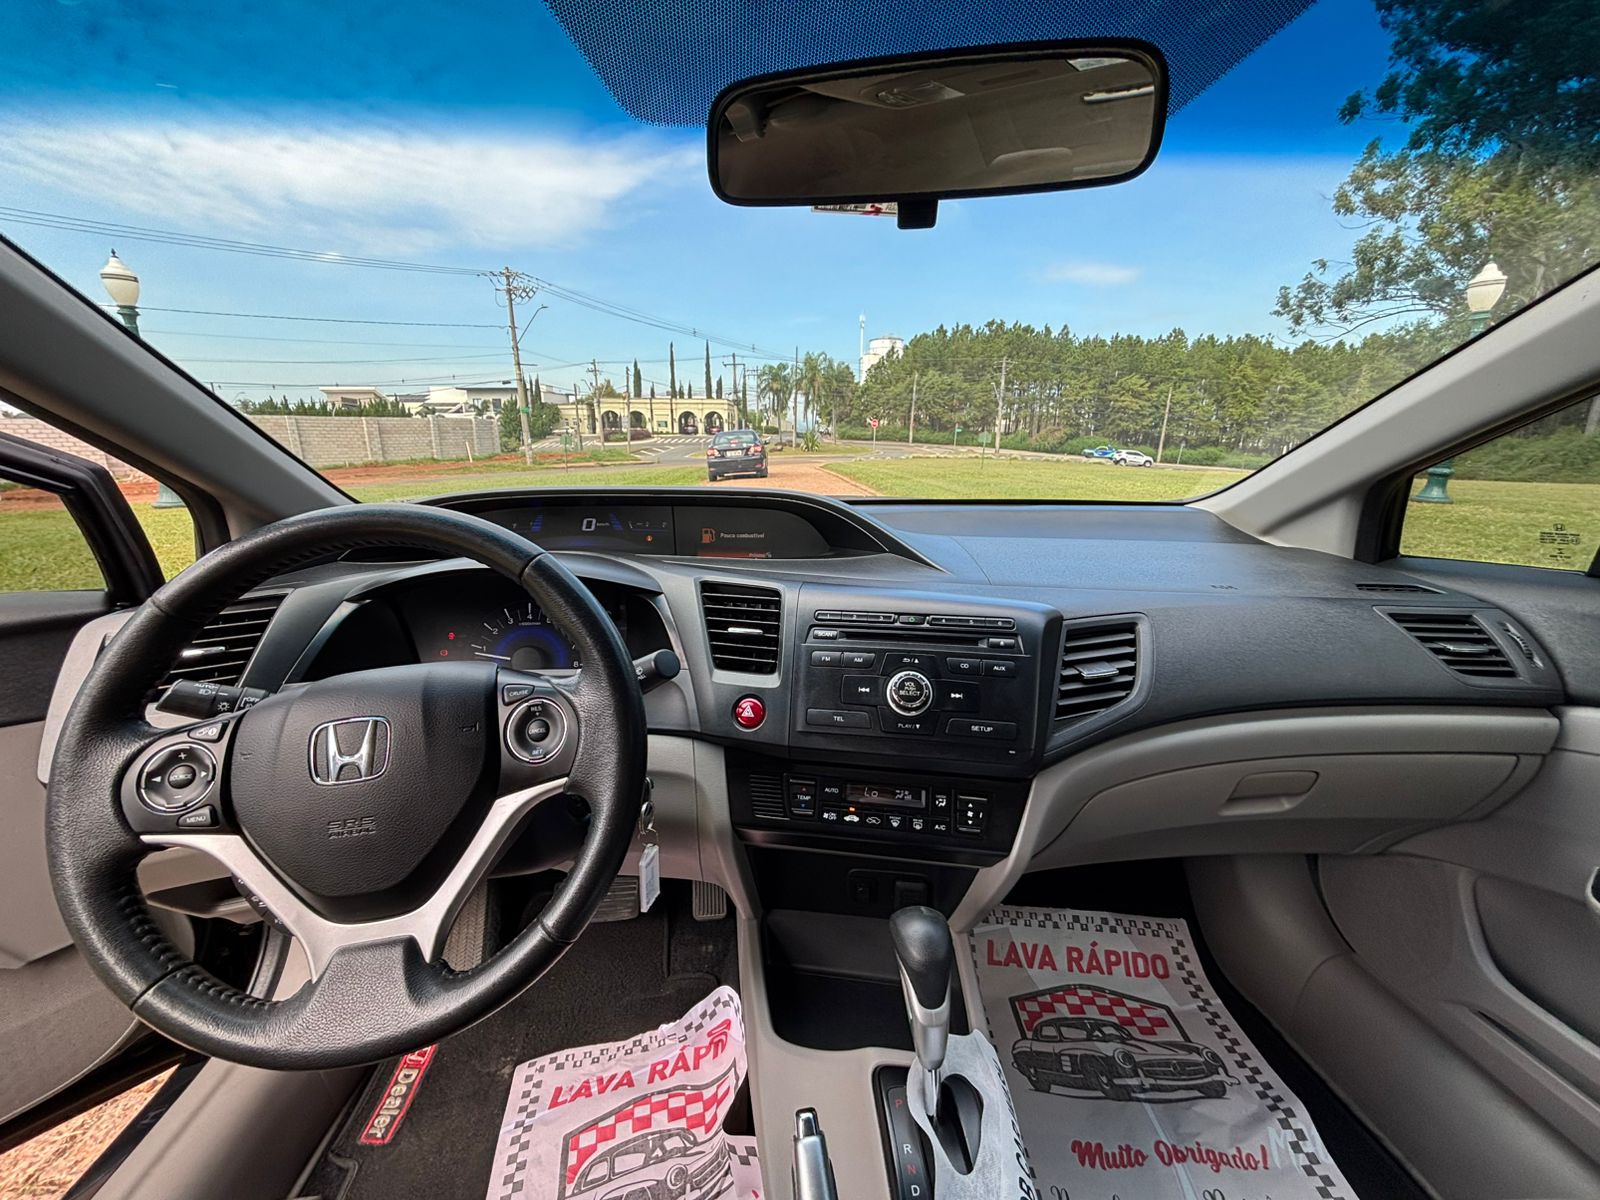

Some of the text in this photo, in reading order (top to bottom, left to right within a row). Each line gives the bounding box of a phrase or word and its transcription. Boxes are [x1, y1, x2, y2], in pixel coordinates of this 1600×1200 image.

[508, 689, 529, 697] CRUISE
[970, 725, 993, 733] SETUP
[186, 815, 206, 823] MENU
[985, 939, 1171, 980] LAVA RÁPIDO
[547, 1070, 636, 1110] LAVA
[368, 1068, 419, 1138] Dealer
[903, 1143, 912, 1154] R
[1071, 1138, 1270, 1173] Muito Obrigado!
[906, 1164, 917, 1175] N
[911, 1184, 920, 1197] D
